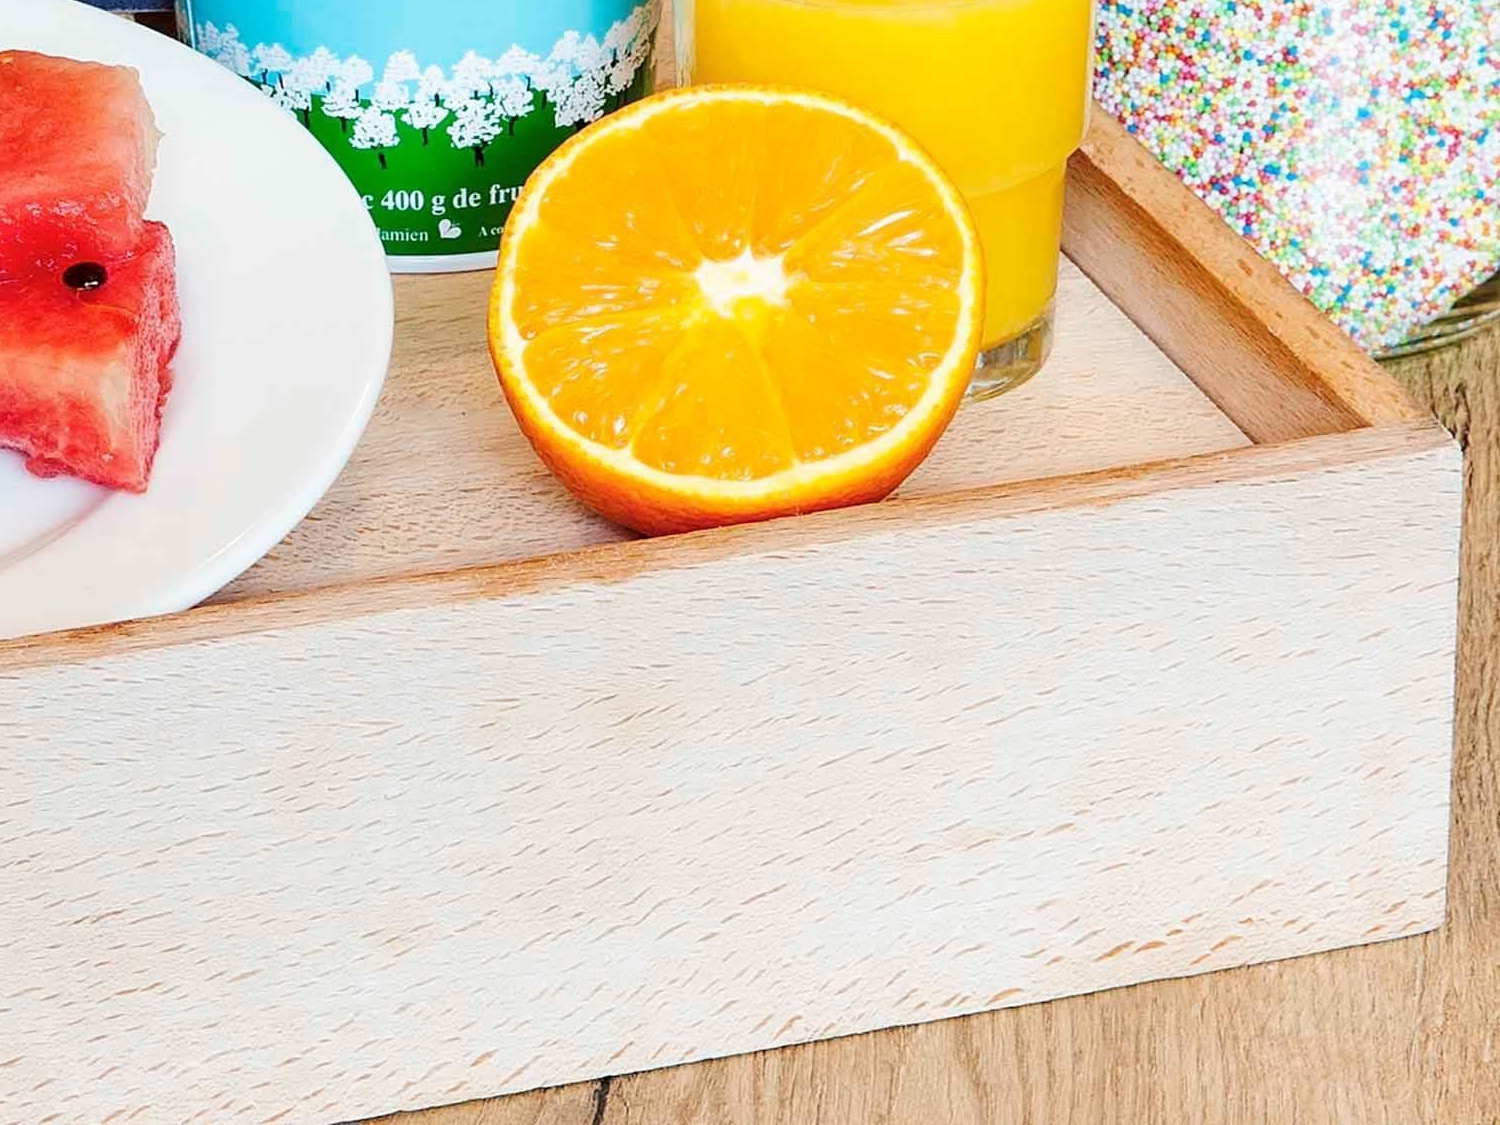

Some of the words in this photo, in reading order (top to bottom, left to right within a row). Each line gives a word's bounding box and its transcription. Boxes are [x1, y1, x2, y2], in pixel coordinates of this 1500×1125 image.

[381, 190, 424, 211] 400
[431, 194, 446, 216] g
[452, 187, 482, 209] de
